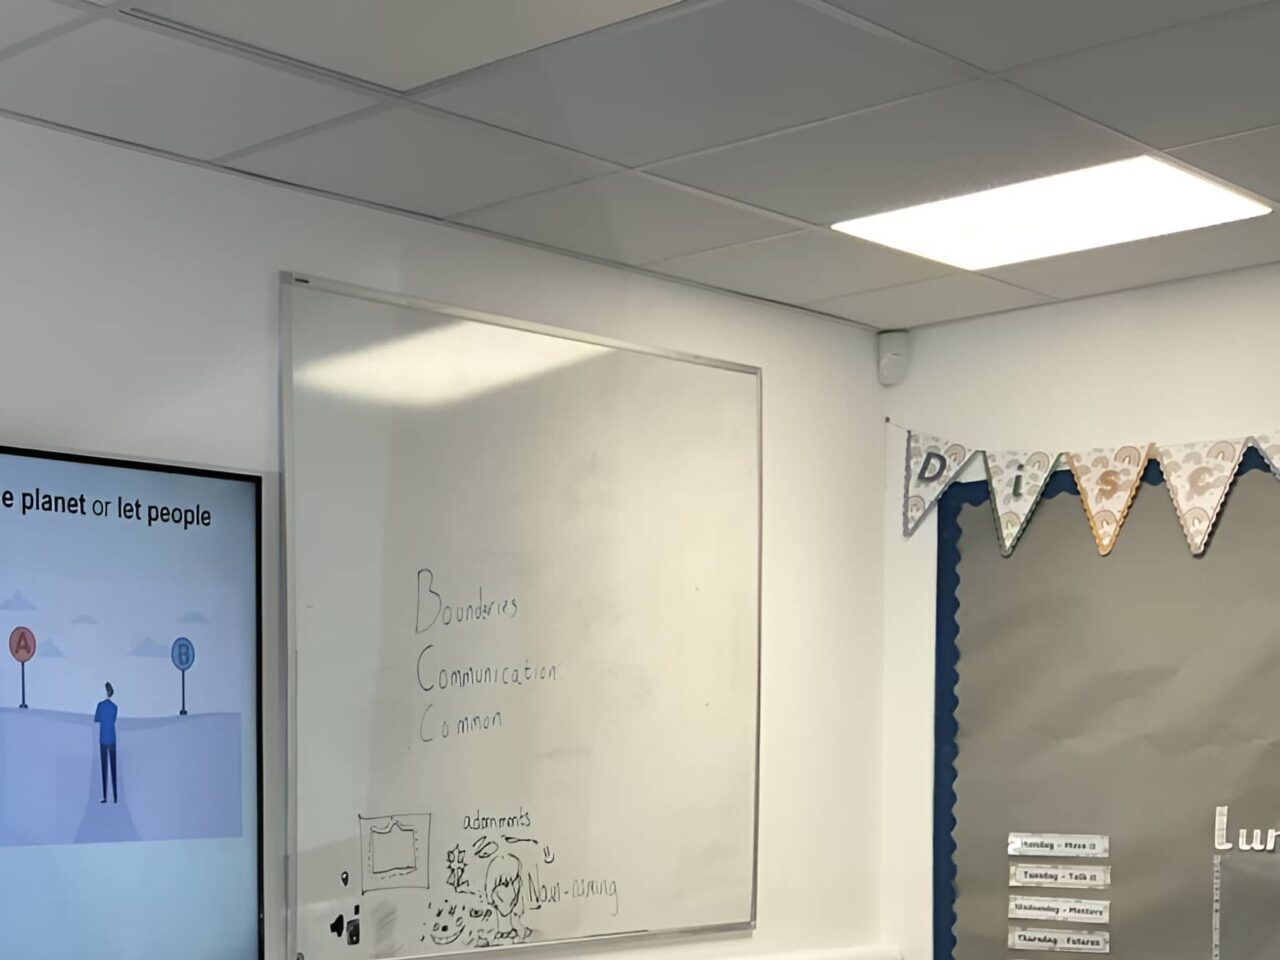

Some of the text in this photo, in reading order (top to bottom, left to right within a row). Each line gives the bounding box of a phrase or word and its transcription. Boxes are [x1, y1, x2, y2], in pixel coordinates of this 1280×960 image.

[21, 488, 87, 516] planet
[91, 499, 112, 517] or
[118, 496, 142, 520] let
[147, 503, 212, 530] people
[15, 631, 31, 654] A
[177, 643, 190, 666] B
[417, 644, 556, 692] Communication
[420, 703, 503, 742] Common
[1023, 871, 1058, 881] Tuesday
